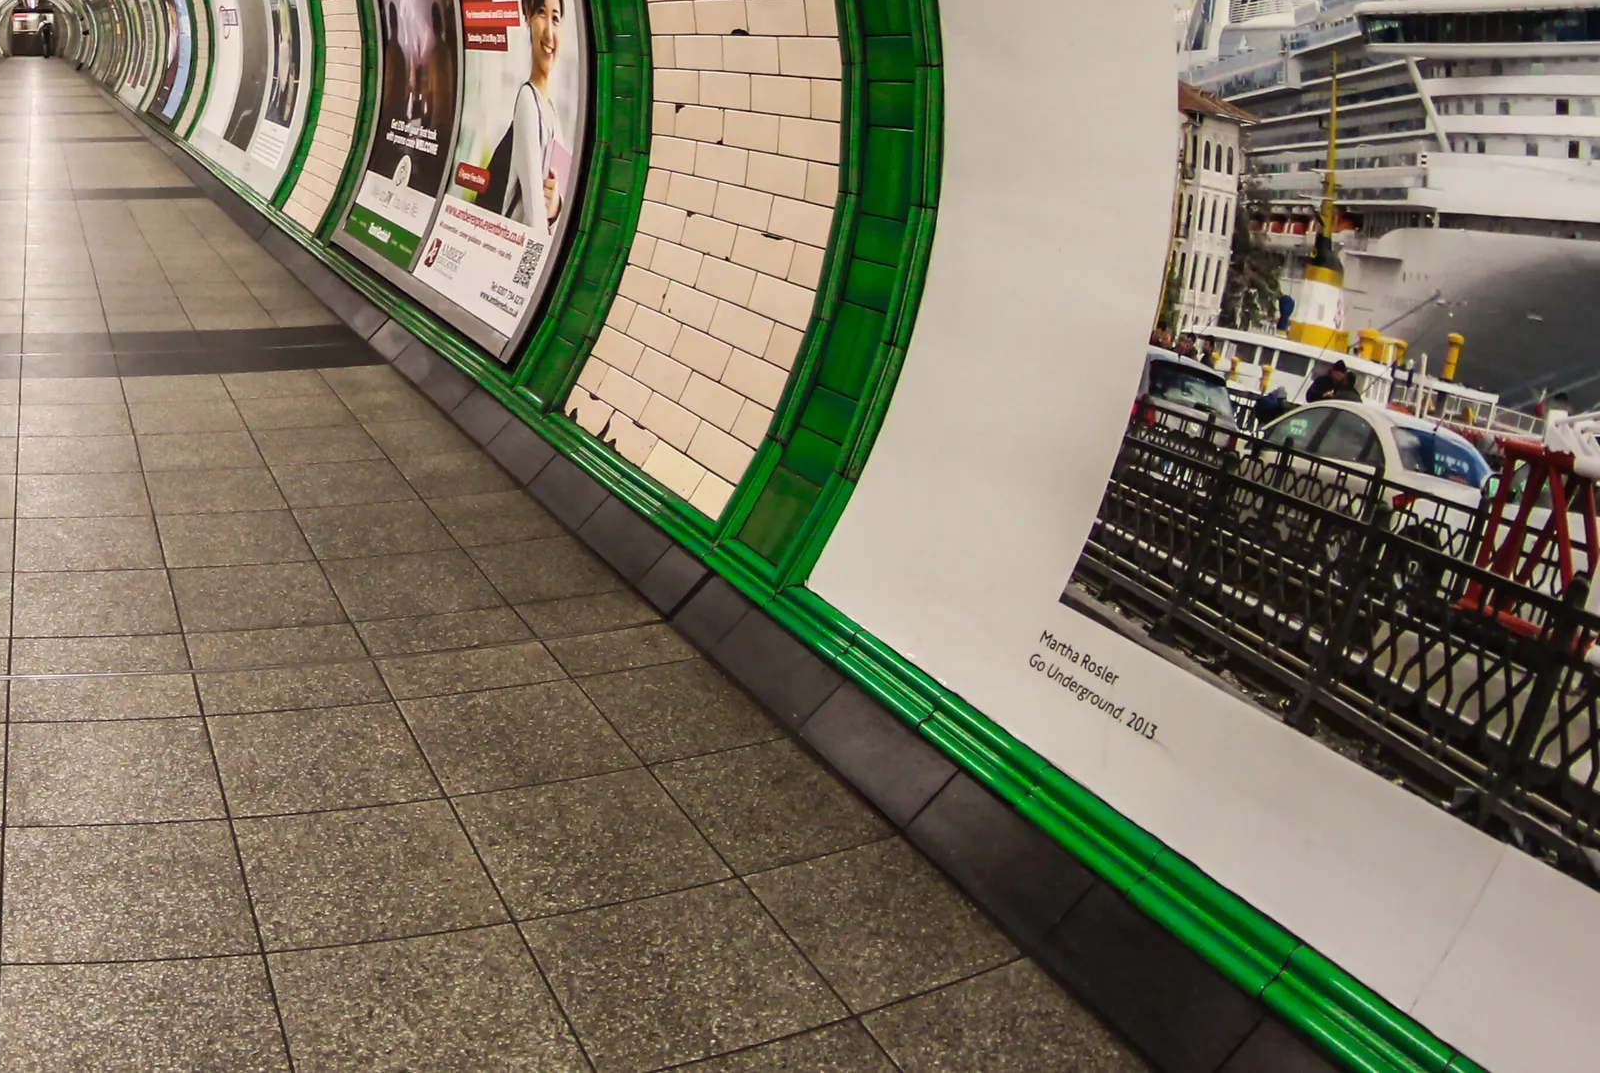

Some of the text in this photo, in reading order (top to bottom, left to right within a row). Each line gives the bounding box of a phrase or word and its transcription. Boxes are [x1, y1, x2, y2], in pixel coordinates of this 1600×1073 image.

[1039, 630, 1120, 686] Martha Rosler
[1029, 653, 1158, 740] Go Underground, 2013
